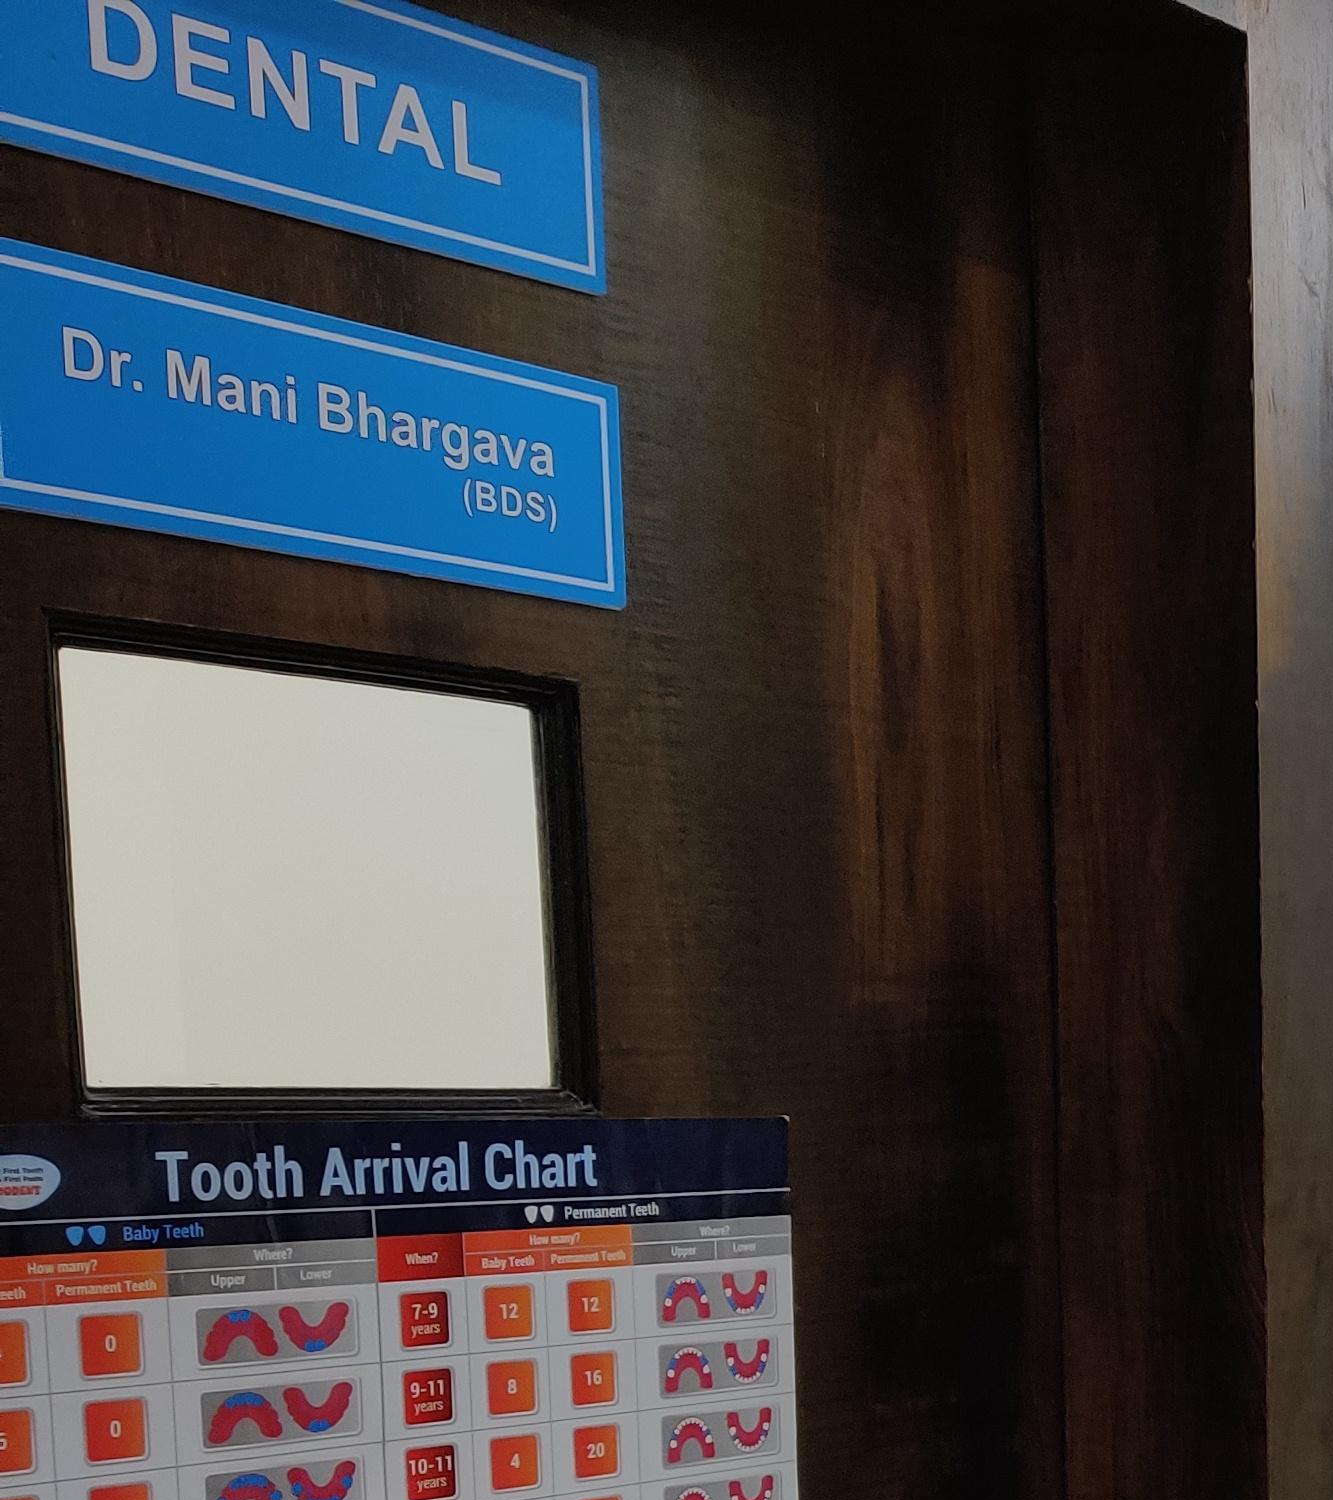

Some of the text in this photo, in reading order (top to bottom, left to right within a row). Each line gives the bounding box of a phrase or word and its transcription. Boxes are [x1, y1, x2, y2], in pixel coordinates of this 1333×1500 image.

[87, 0, 502, 187] DENTAL
[61, 325, 556, 479] Dr. Mani Bhargava
[462, 478, 558, 533] (BDS)
[154, 1139, 599, 1203] Tooth Arrival Chart
[563, 1201, 660, 1220] Permanent Teeth
[122, 1222, 205, 1245] Baby Teeth
[699, 1224, 731, 1237] Where?
[528, 1231, 582, 1247] How many?
[253, 1247, 294, 1262] Where?
[671, 1244, 697, 1258] Upper
[732, 1241, 758, 1254] Lower
[405, 1251, 439, 1266] When?
[481, 1254, 536, 1270] Baby Teeth
[550, 1249, 627, 1265] Permanent Teeth
[27, 1258, 99, 1275] How many?
[210, 1272, 247, 1289] Upper
[300, 1268, 333, 1282] Lower
[56, 1279, 158, 1298] Permanent Teeth
[411, 1303, 439, 1320] 7-9
[499, 1303, 520, 1319] 12
[582, 1297, 600, 1313] 12
[411, 1322, 441, 1337] years
[105, 1335, 117, 1353] 0
[584, 1370, 603, 1386] 16
[409, 1379, 446, 1398] 9-11
[507, 1379, 518, 1394] 8
[414, 1399, 445, 1415] years
[110, 1420, 122, 1438] 0
[586, 1442, 606, 1459] 20
[408, 1456, 453, 1476] 10-11
[510, 1454, 521, 1469] 4
[416, 1475, 448, 1491] years
